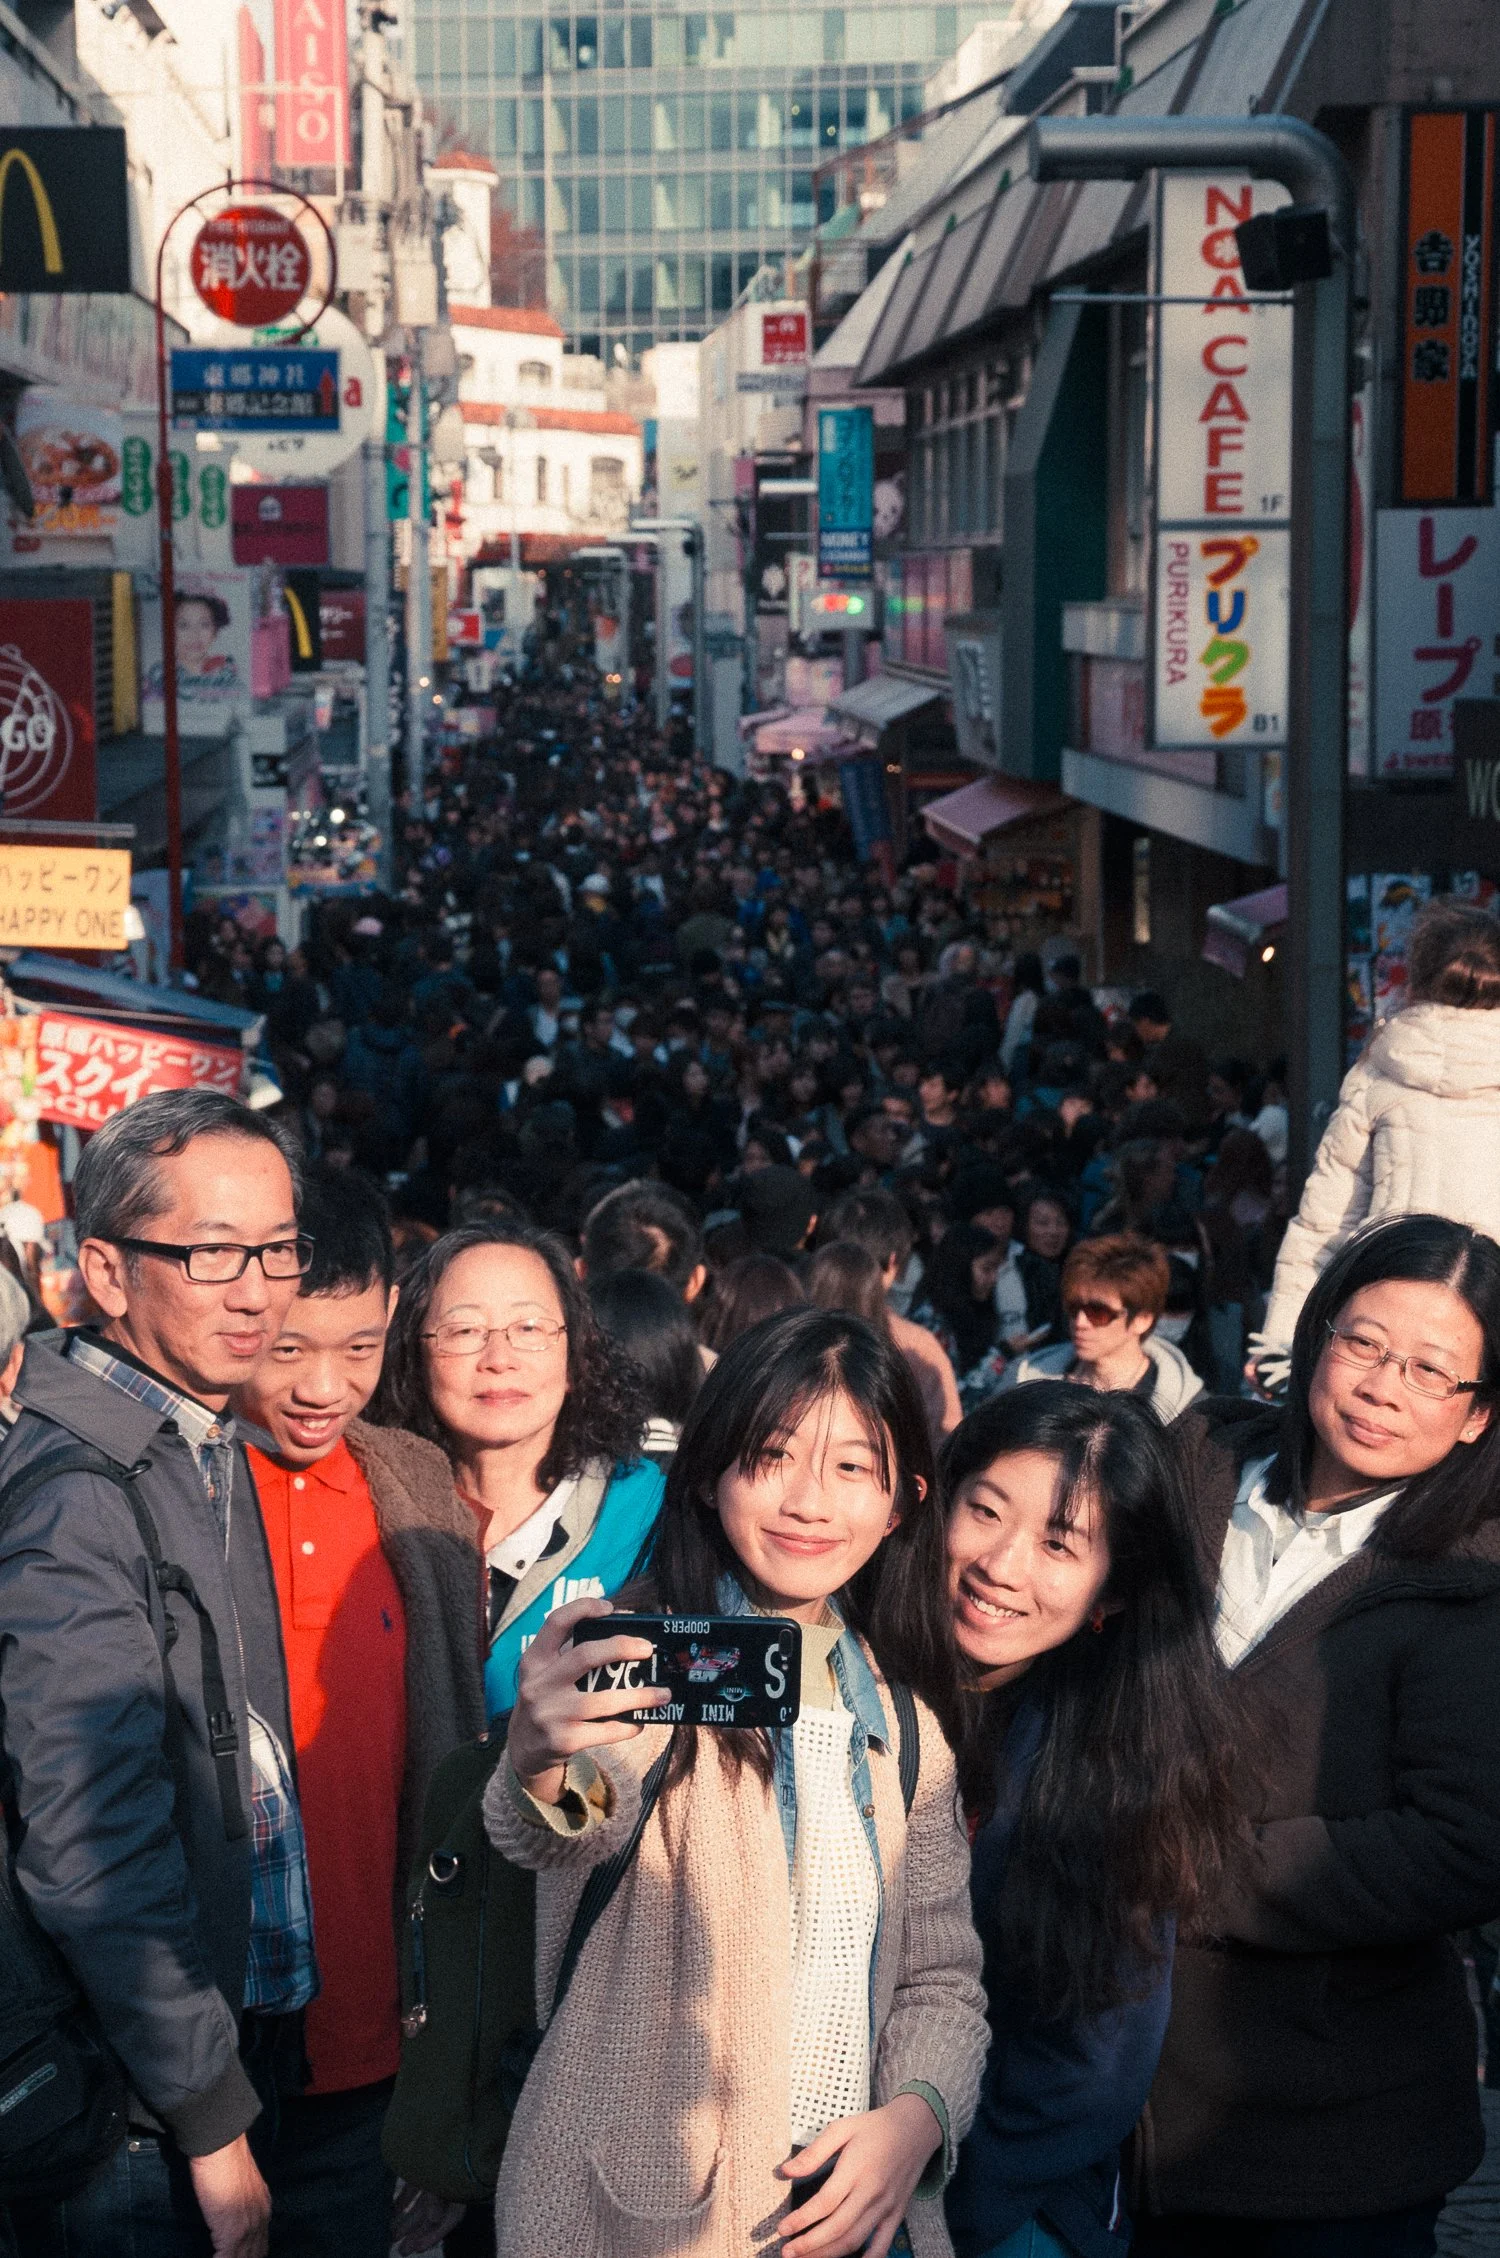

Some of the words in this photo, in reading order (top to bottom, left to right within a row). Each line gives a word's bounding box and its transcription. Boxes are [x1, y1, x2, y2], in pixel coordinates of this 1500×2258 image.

[200, 241, 302, 290] 消火栓
[1202, 184, 1253, 314] NOA
[1199, 333, 1250, 515] CAFE
[1261, 494, 1284, 512] 1F
[1167, 541, 1189, 685] PURIKURA
[1412, 508, 1484, 703] レープ
[1200, 535, 1260, 739] プリクラ
[1253, 713, 1280, 732] B1
[76, 908, 121, 938] ONE
[701, 1704, 735, 1722] MINI
[725, 1686, 744, 1696] MINI
